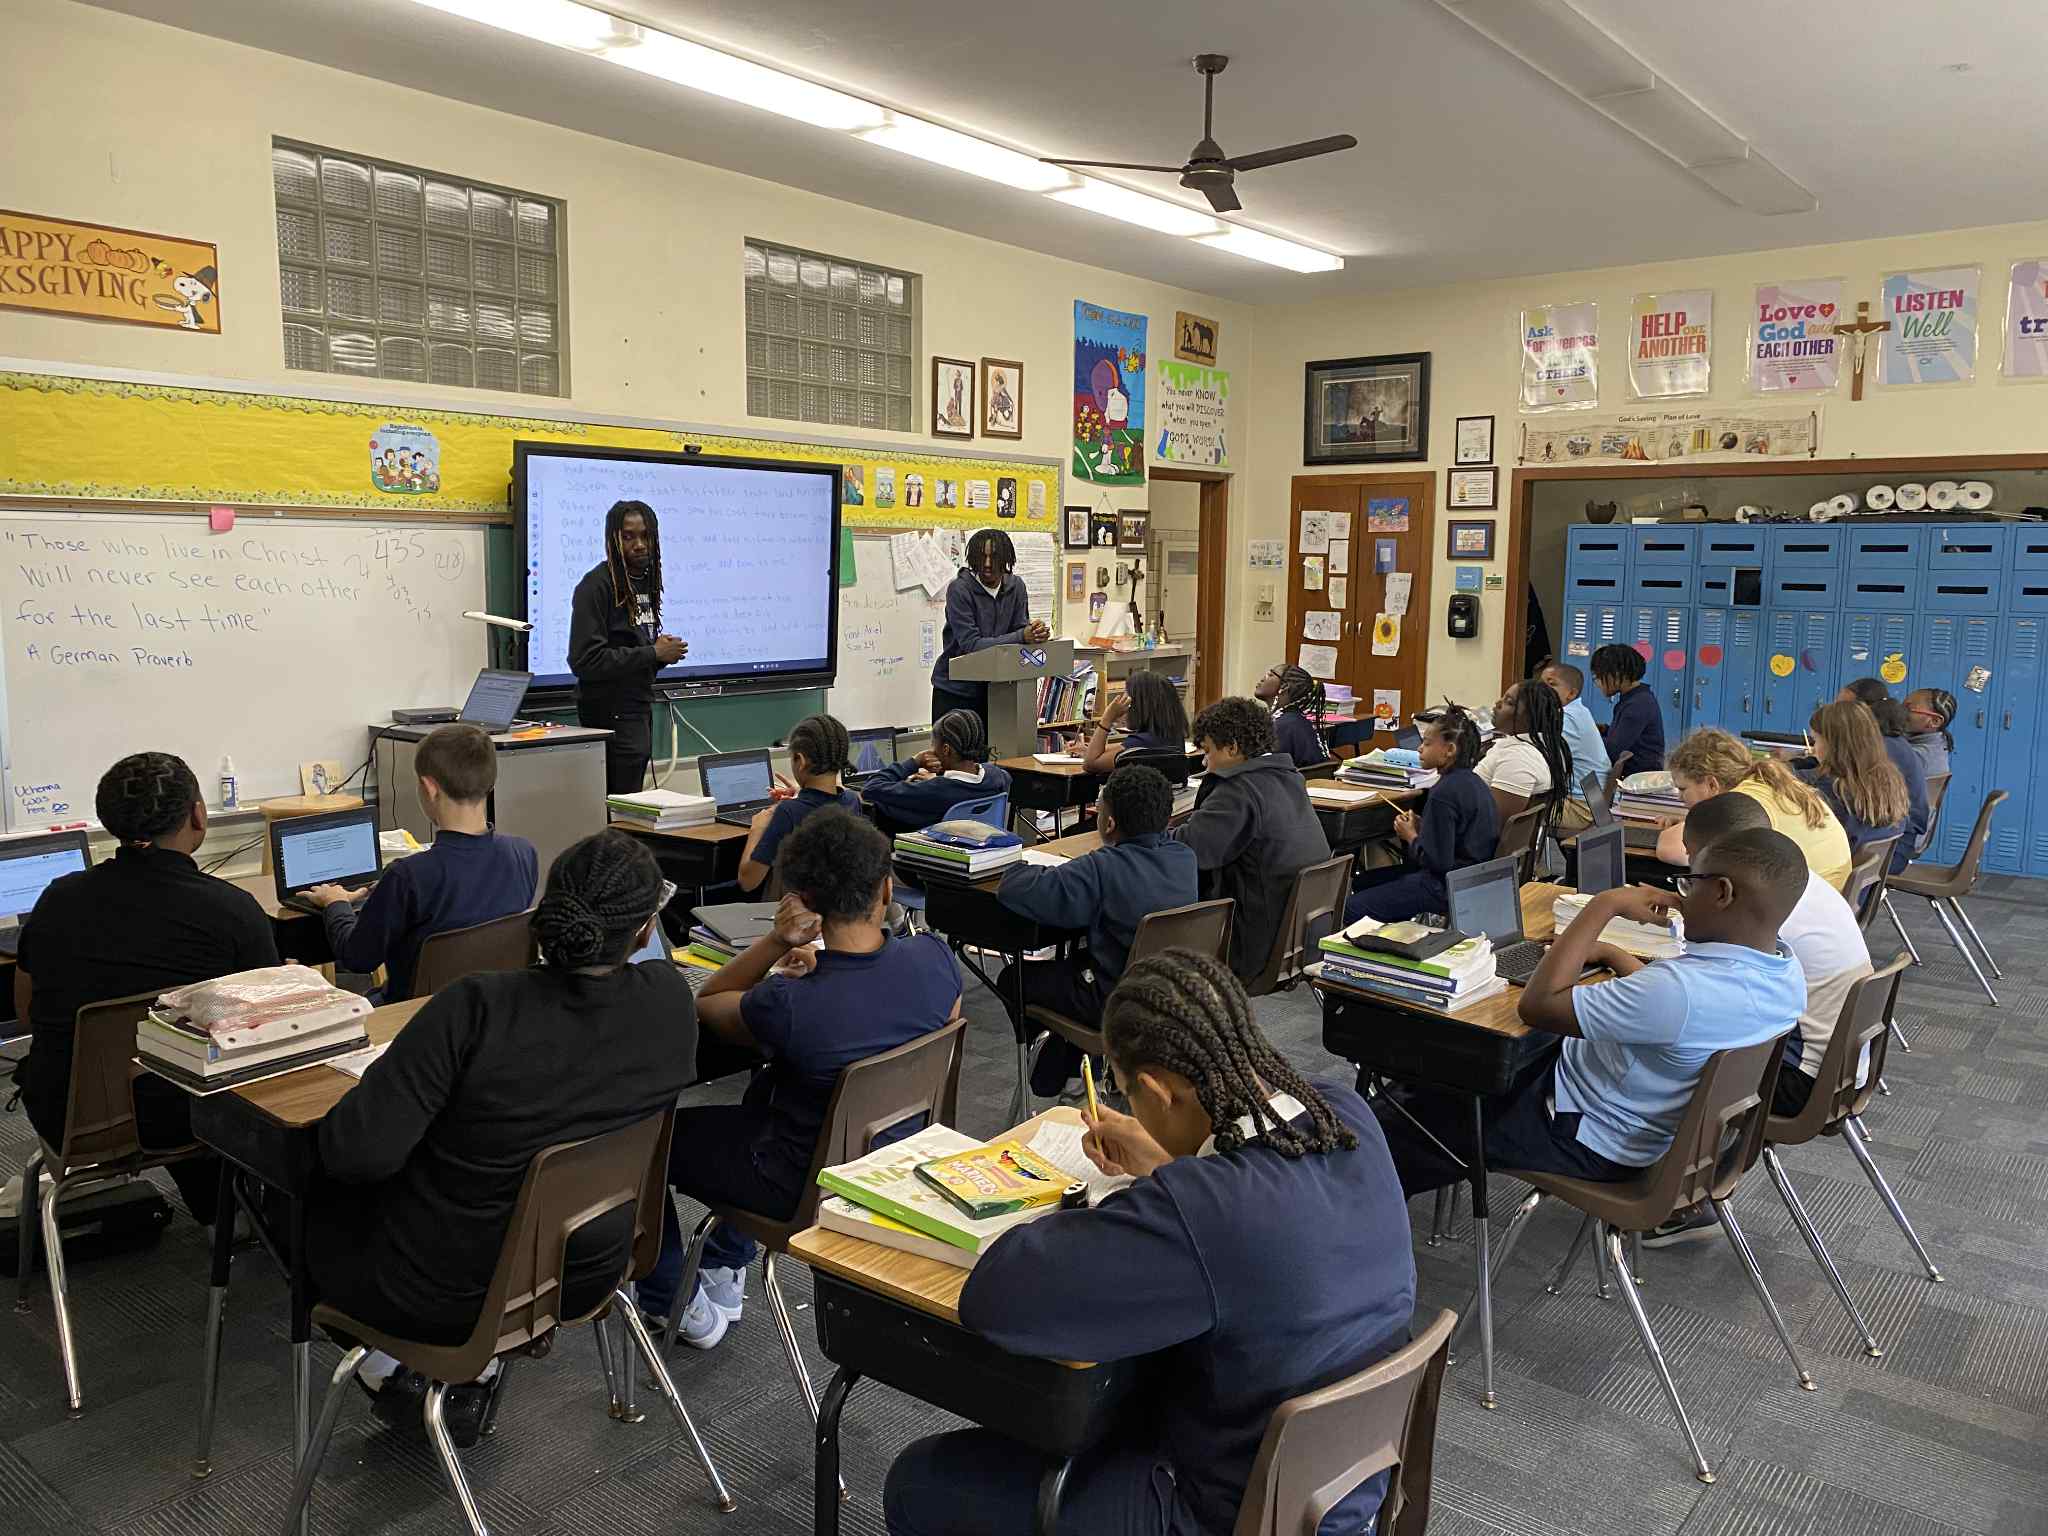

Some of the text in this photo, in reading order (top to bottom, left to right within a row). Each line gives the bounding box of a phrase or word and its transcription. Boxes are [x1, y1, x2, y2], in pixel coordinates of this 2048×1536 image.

[1760, 303, 1817, 322] Love
[1895, 290, 1964, 313] LISTEN
[1528, 326, 1553, 338] Ask
[1641, 311, 1687, 338] HELP
[1760, 320, 1806, 341] God
[1903, 311, 1954, 338] Well
[1638, 335, 1707, 359] ANOTHER
[1757, 339, 1834, 359] EACH OTHER
[1195, 388, 1216, 401] KNOW
[1161, 400, 1174, 410] what
[1175, 404, 1185, 412] you
[1196, 404, 1225, 417] DISCOVER
[1173, 416, 1187, 425] when
[102, 537, 150, 556] who
[160, 534, 207, 560] live
[211, 546, 233, 560] in
[242, 539, 328, 567] Christ
[19, 563, 73, 588] Will
[87, 568, 160, 587] never
[169, 570, 220, 590] see
[235, 574, 294, 595] each
[16, 599, 56, 625] for
[71, 602, 120, 630] the
[131, 601, 193, 632] last
[26, 643, 193, 668] A German Proverb
